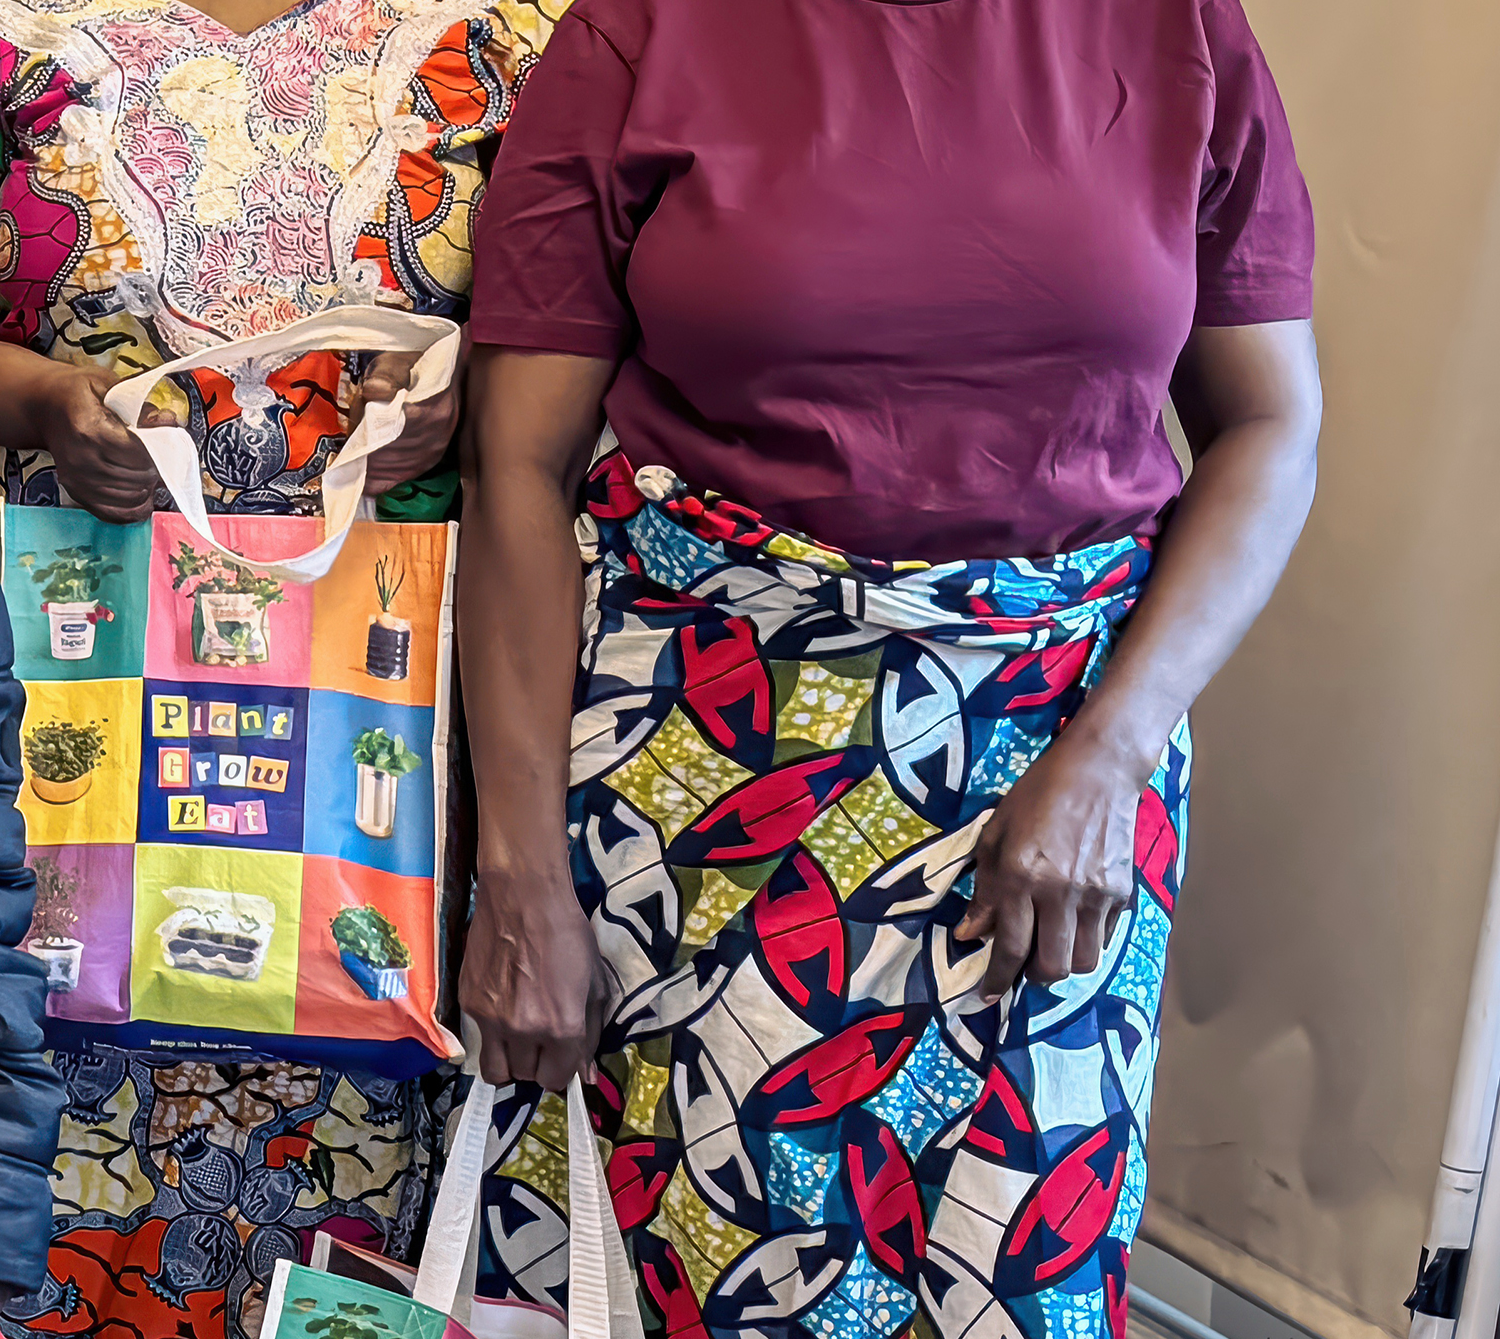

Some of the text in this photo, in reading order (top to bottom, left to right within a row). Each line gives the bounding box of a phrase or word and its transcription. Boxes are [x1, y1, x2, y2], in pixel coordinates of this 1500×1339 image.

[160, 702, 288, 735] Plant
[163, 752, 283, 784] Grow
[174, 801, 258, 831] Eat
